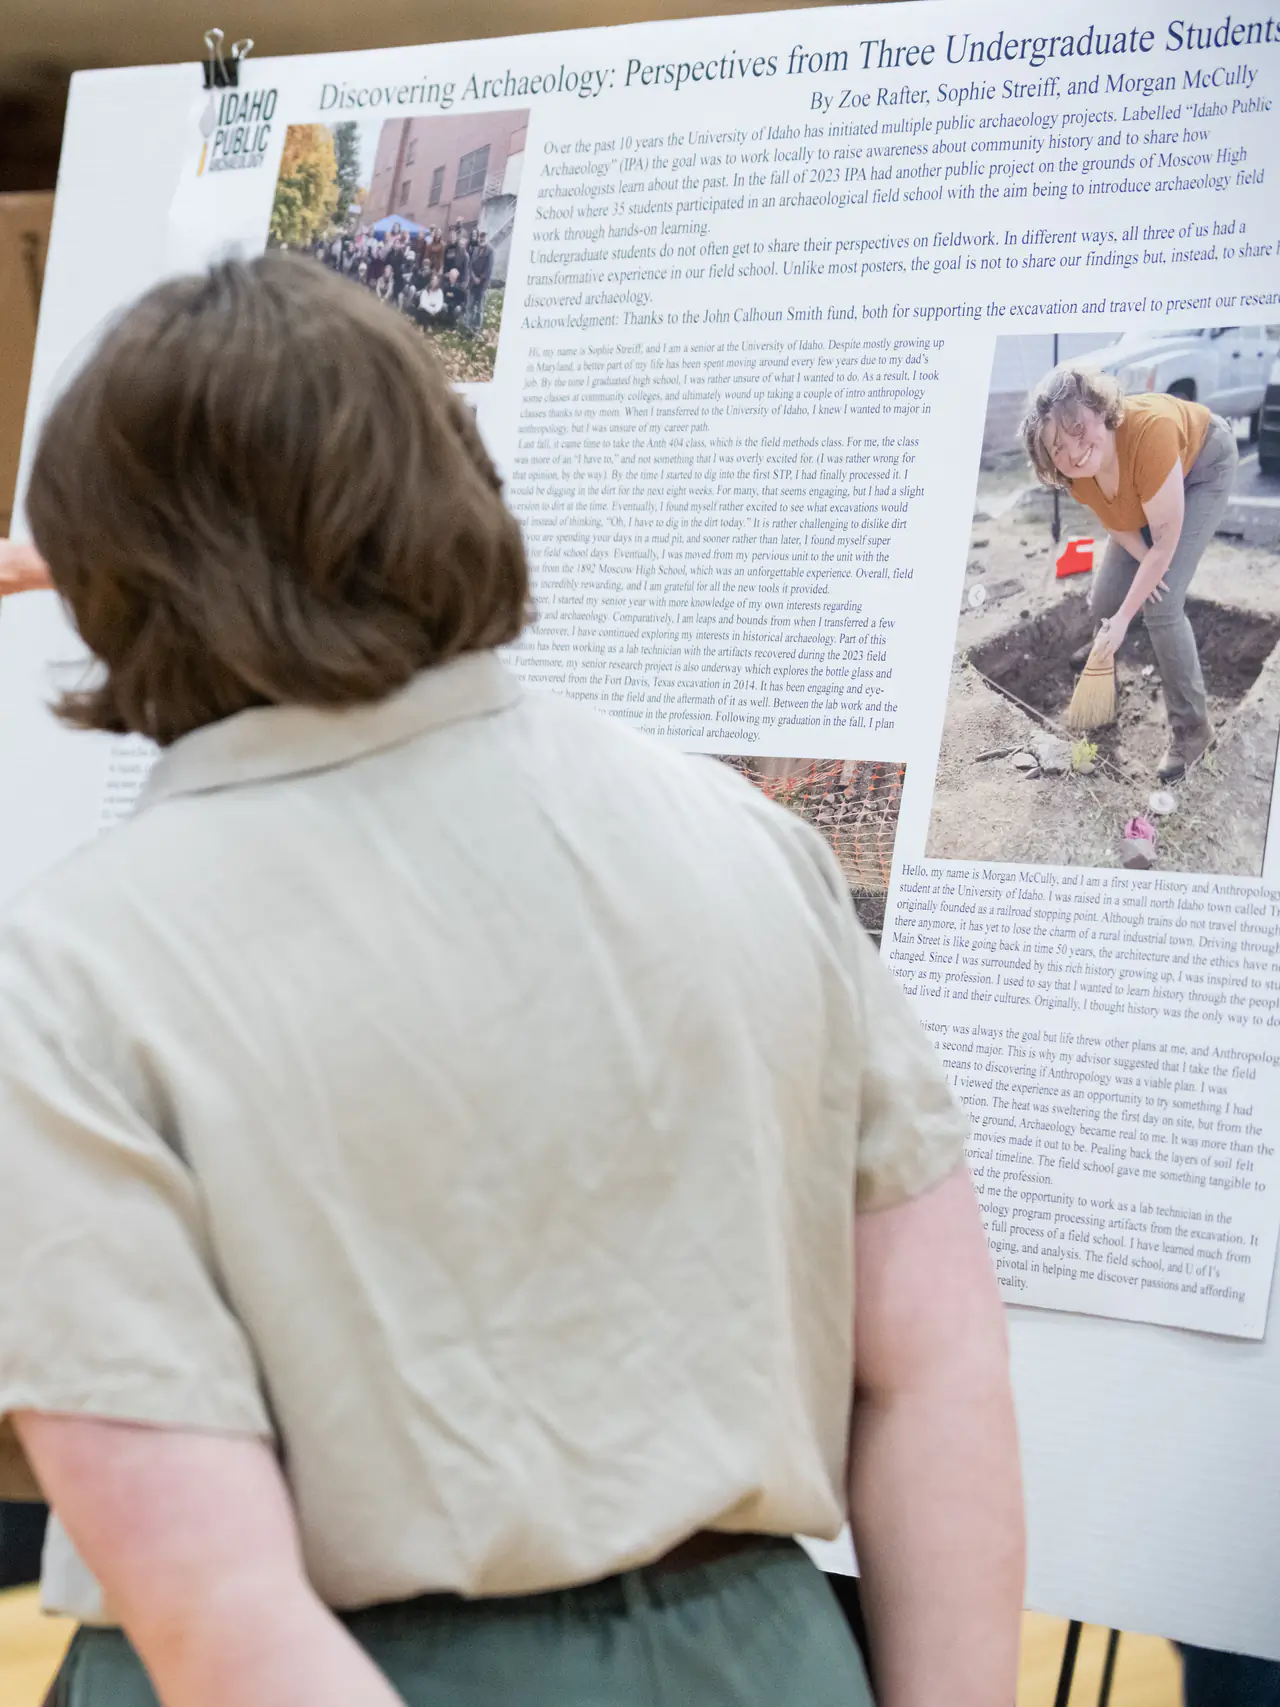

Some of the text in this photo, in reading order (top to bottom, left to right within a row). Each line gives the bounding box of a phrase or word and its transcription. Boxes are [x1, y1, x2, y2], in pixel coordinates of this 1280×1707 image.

[319, 75, 456, 110] Discovering
[461, 64, 615, 100] Archaeology:
[624, 49, 777, 91] Perspectives
[787, 44, 848, 74] from
[859, 38, 935, 69] Three
[946, 24, 1155, 67] Undergraduate
[810, 64, 1258, 112] By Zoe Rafter, Sophie Streiff, and Morgan McCully
[218, 88, 277, 126] IDAHO
[212, 124, 271, 157] PUBLIC
[543, 141, 572, 154] Over
[574, 139, 591, 153] the
[593, 139, 615, 155] past
[619, 135, 633, 150] 10
[634, 137, 664, 152] years
[667, 131, 685, 146] the
[688, 128, 748, 145] University
[751, 126, 766, 141] of
[767, 124, 801, 140] Idaho
[803, 123, 824, 138] has
[828, 119, 879, 136] initiated
[881, 116, 932, 136] multiple
[935, 114, 975, 135] public
[978, 111, 1059, 130] archaeology
[1061, 108, 1117, 129] projects.
[1121, 104, 1182, 121] Labelled
[1231, 96, 1272, 114] Public
[619, 157, 649, 173] (IPA)
[652, 155, 669, 169] the
[671, 152, 696, 168] goal
[700, 155, 722, 166] was
[725, 154, 737, 165] to
[740, 148, 769, 163] work
[773, 146, 814, 162] locally
[817, 148, 830, 160] to
[833, 144, 863, 159] raise
[866, 144, 928, 158] awareness
[931, 139, 966, 154] about
[970, 135, 1044, 154] community
[1048, 133, 1094, 151] history
[1097, 130, 1122, 146] and
[1126, 132, 1139, 145] to
[1143, 129, 1179, 144] share
[1182, 127, 1210, 142] how
[535, 168, 1265, 220] School where 35 students participated in an archaeological field school with the aim being to introduce archaeology field
[532, 219, 710, 243] work through hands-on learning.
[520, 313, 619, 331] Acknowledgment:
[623, 310, 664, 325] Thanks
[667, 313, 679, 324] to
[682, 309, 700, 324] the
[702, 308, 730, 323] John
[733, 307, 783, 322] Calhoun
[786, 305, 823, 321] Smith
[827, 304, 857, 320] fund,
[861, 304, 888, 319] both
[892, 303, 910, 318] for
[912, 302, 982, 321] supporting
[986, 301, 1006, 316] the
[1009, 299, 1078, 316] excavation
[1081, 298, 1106, 314] and
[1109, 296, 1147, 313] travel
[1150, 299, 1163, 311] to
[1165, 296, 1212, 315] present
[1215, 296, 1237, 308] our
[523, 289, 653, 308] discovered archaeology.
[551, 640, 570, 651] been
[572, 642, 605, 656] working
[626, 643, 639, 654] lab
[640, 643, 682, 656] technician
[683, 644, 701, 656] with
[703, 645, 716, 656] the
[717, 646, 752, 657] artifacts
[754, 648, 797, 659] recovered
[797, 648, 825, 663] during
[827, 648, 841, 660] the
[841, 649, 864, 661] 2023
[866, 650, 887, 662] field
[658, 724, 665, 735] in
[666, 724, 705, 737] historical
[930, 869, 944, 877] my
[945, 869, 970, 879] name
[972, 868, 980, 880] is
[981, 868, 1016, 884] Morgan
[1061, 874, 1078, 886] and
[1085, 877, 1100, 887] am
[1102, 879, 1108, 887] a
[1111, 876, 1129, 888] first
[1131, 880, 1152, 890] year
[1154, 878, 1188, 895] History
[1191, 881, 1210, 894] and
[995, 1256, 1246, 1303] pivotal in helping me discover passions and affording
